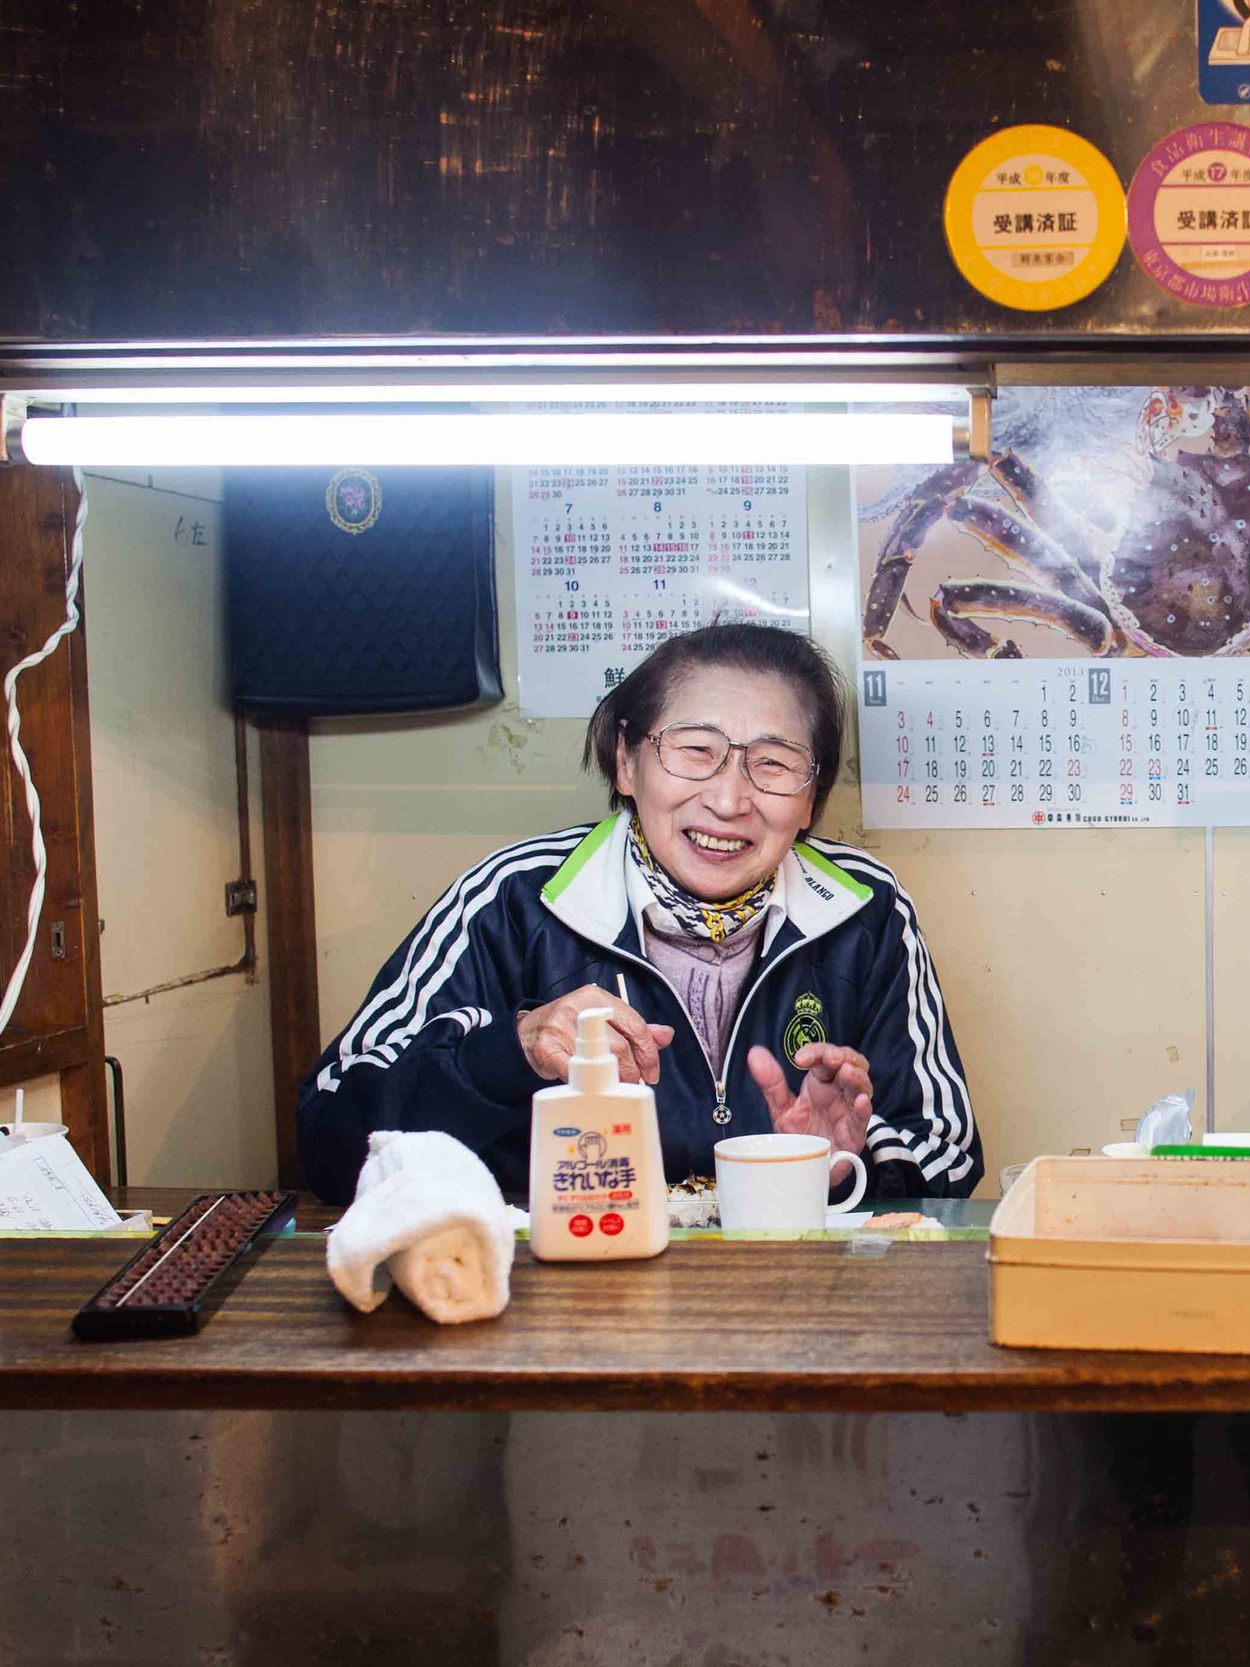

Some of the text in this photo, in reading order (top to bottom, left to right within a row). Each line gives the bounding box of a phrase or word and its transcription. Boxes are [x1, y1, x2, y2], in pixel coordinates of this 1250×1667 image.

[993, 212, 1077, 233] 受講済証
[565, 500, 752, 514] 7 8 9
[565, 580, 666, 592] 10 11
[866, 674, 883, 699] 11
[1091, 671, 1108, 695] 12
[1041, 684, 1076, 701] 1 2
[1122, 685, 1127, 702] 1
[1150, 684, 1157, 701] 2
[1178, 684, 1186, 701] 3
[1207, 684, 1215, 701] 4
[1236, 683, 1244, 700] 5
[897, 710, 1077, 728] 3 4 5 6 7 8 9
[1122, 709, 1129, 726] 8
[1150, 709, 1158, 726] 9
[1177, 709, 1190, 726] 10
[1206, 709, 1216, 726] 11
[1234, 708, 1247, 725] 12
[896, 735, 1081, 753] 10 11 12 13 14 15 16
[1120, 734, 1133, 751] 15
[1148, 734, 1161, 751] 16
[1177, 734, 1190, 751] 17
[1206, 734, 1219, 751] 18
[1234, 733, 1247, 750] 19
[897, 759, 1081, 777] 17 18 19 20 21 22 23
[1119, 759, 1133, 776] 22
[1147, 759, 1162, 776] 23
[1176, 758, 1190, 775] 24
[1205, 758, 1219, 775] 25
[1234, 758, 1247, 775] 26
[896, 784, 1082, 802] 24 25 26 27 28 29 30
[1119, 783, 1189, 801] 29 30 31
[805, 877, 835, 901] BLANCO
[556, 1157, 630, 1171] アルコール消毒
[553, 1168, 637, 1191] きれいな手
